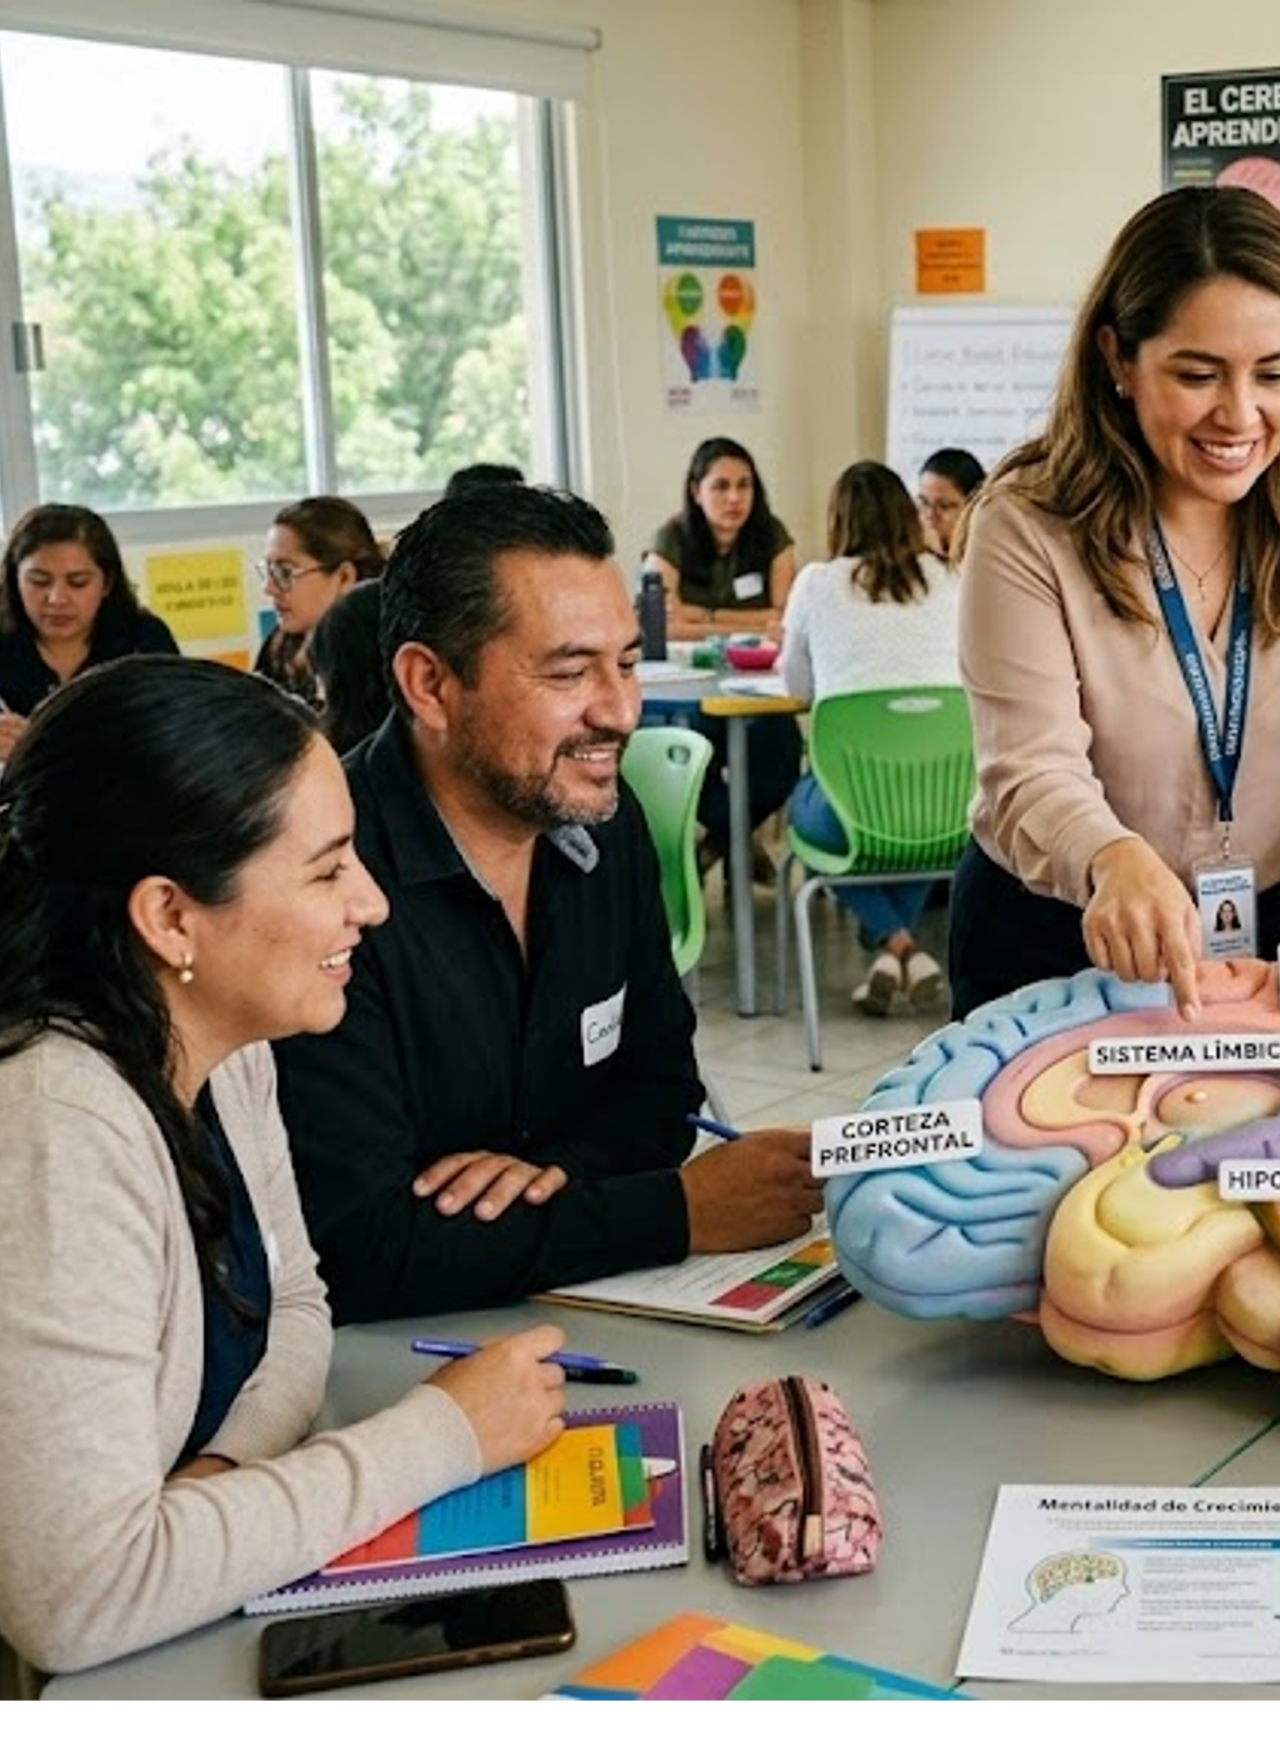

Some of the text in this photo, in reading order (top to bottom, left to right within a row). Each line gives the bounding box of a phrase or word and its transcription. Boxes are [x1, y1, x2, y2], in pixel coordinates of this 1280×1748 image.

[1183, 86, 1216, 115] EL
[1096, 1044, 1197, 1065] SISTEMA
[841, 1111, 951, 1140] CORTEZA
[819, 1131, 975, 1167] PREFRONTAL
[1036, 1497, 1158, 1513] Mentalidad
